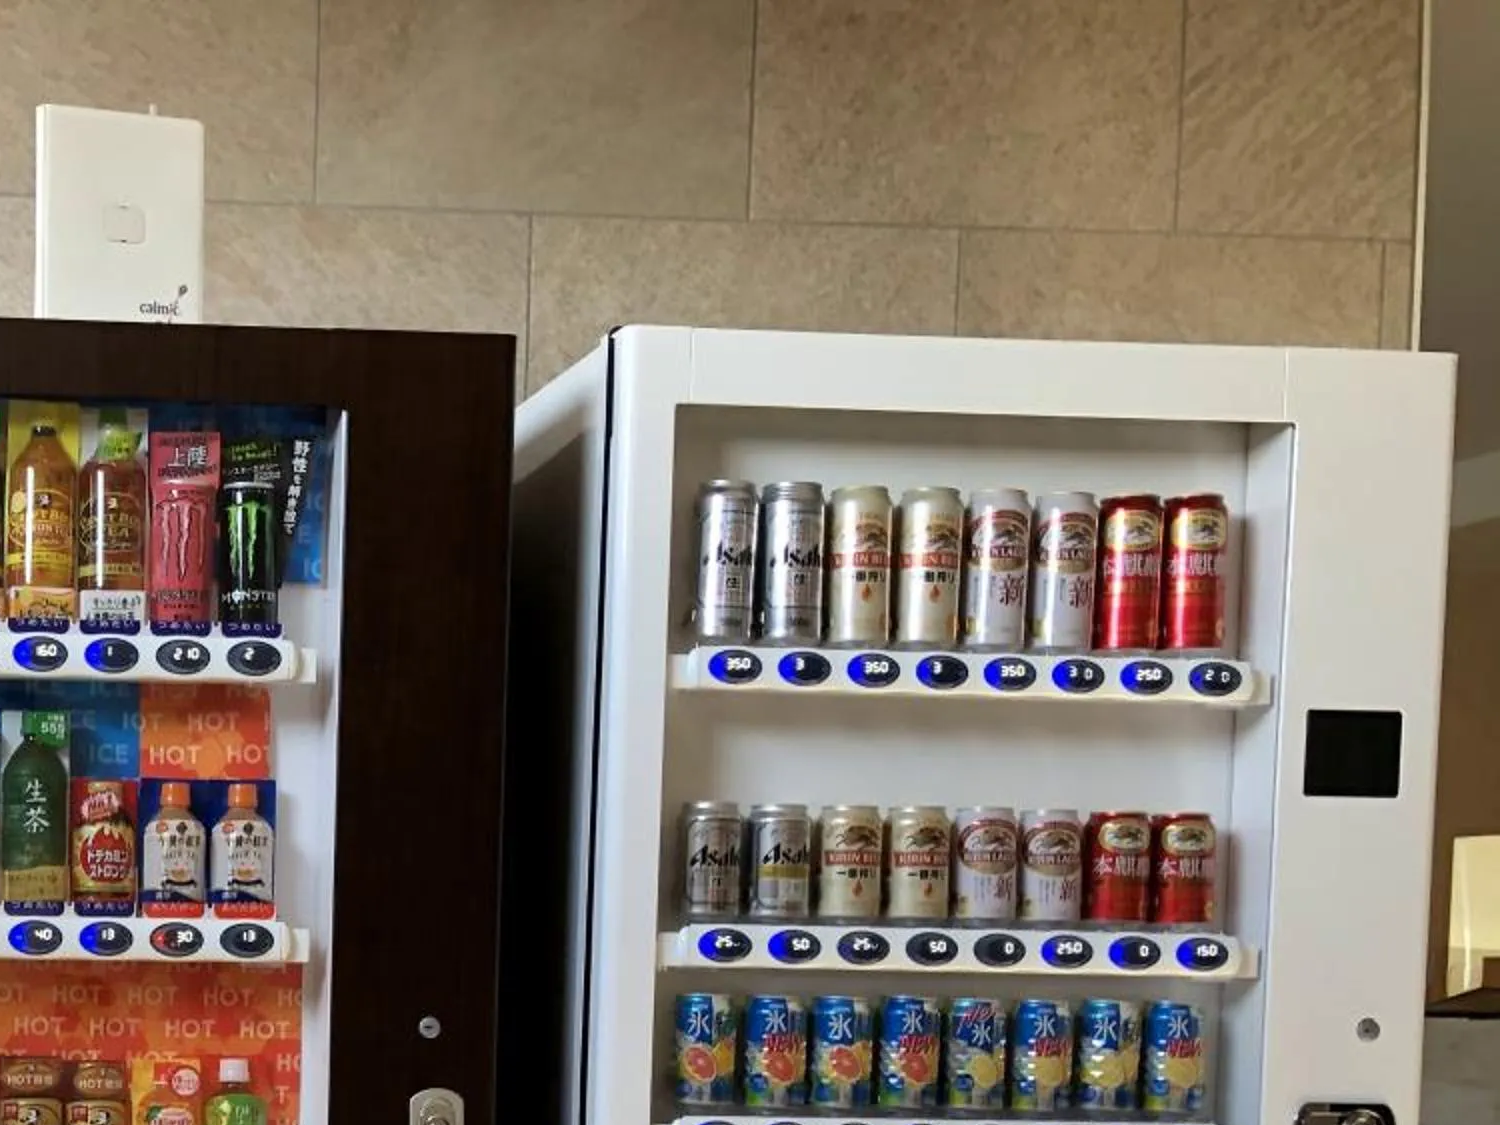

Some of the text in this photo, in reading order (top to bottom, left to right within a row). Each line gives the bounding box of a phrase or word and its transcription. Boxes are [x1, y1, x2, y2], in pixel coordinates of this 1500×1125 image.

[139, 301, 179, 316] calmic
[149, 746, 201, 765] HOT
[23, 778, 49, 833] 生茶
